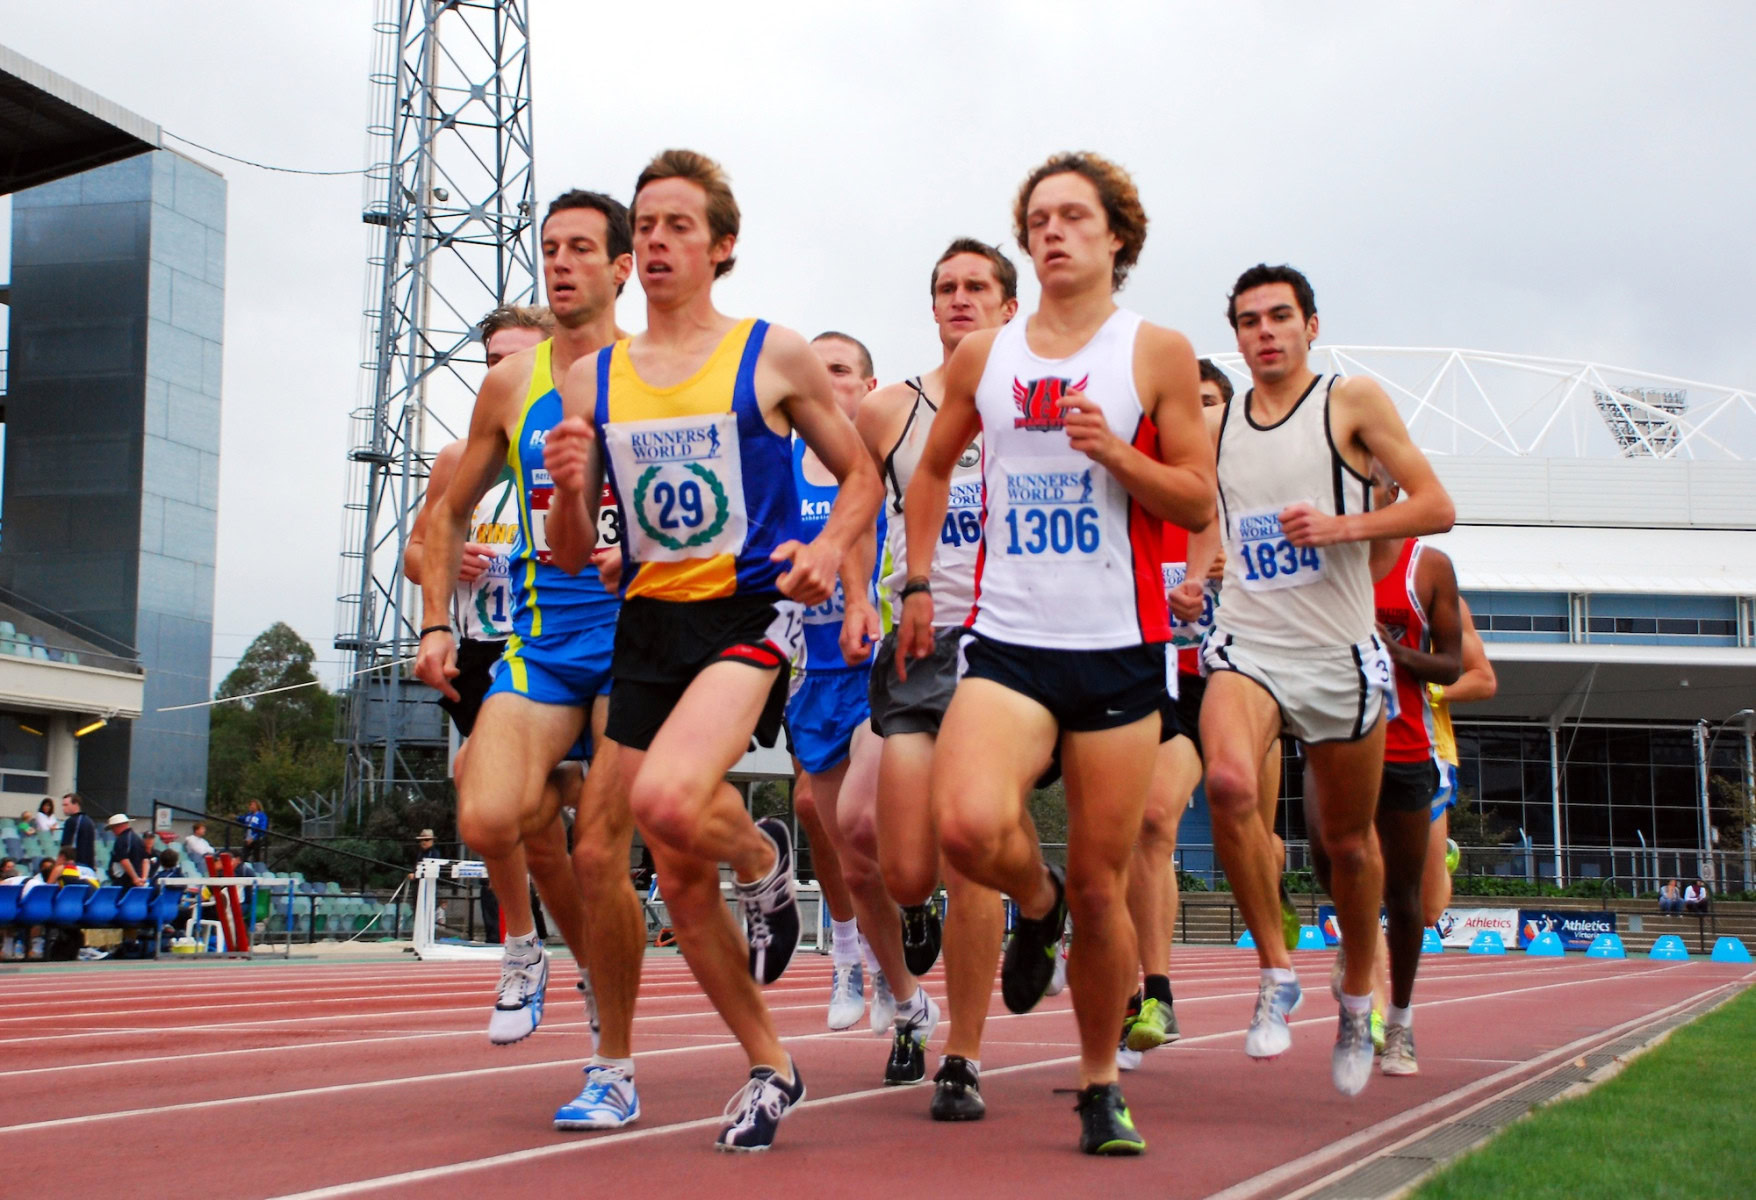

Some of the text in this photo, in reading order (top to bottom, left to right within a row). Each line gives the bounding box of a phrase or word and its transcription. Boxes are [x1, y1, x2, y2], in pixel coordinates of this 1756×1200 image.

[631, 429, 706, 446] RUNNERS
[633, 443, 692, 459] WORLD
[1007, 473, 1079, 487] RUNNERS
[1007, 487, 1065, 501] WORLD
[653, 480, 704, 529] 29
[941, 510, 982, 548] 46
[1005, 507, 1100, 555] 1306
[1240, 540, 1320, 580] 1834
[1376, 660, 1389, 682] 3
[1464, 917, 1512, 929] Athletics
[1561, 919, 1611, 932] Athletics
[1484, 935, 1492, 943] 5
[1666, 940, 1674, 948] 2
[1727, 942, 1735, 951] 1
